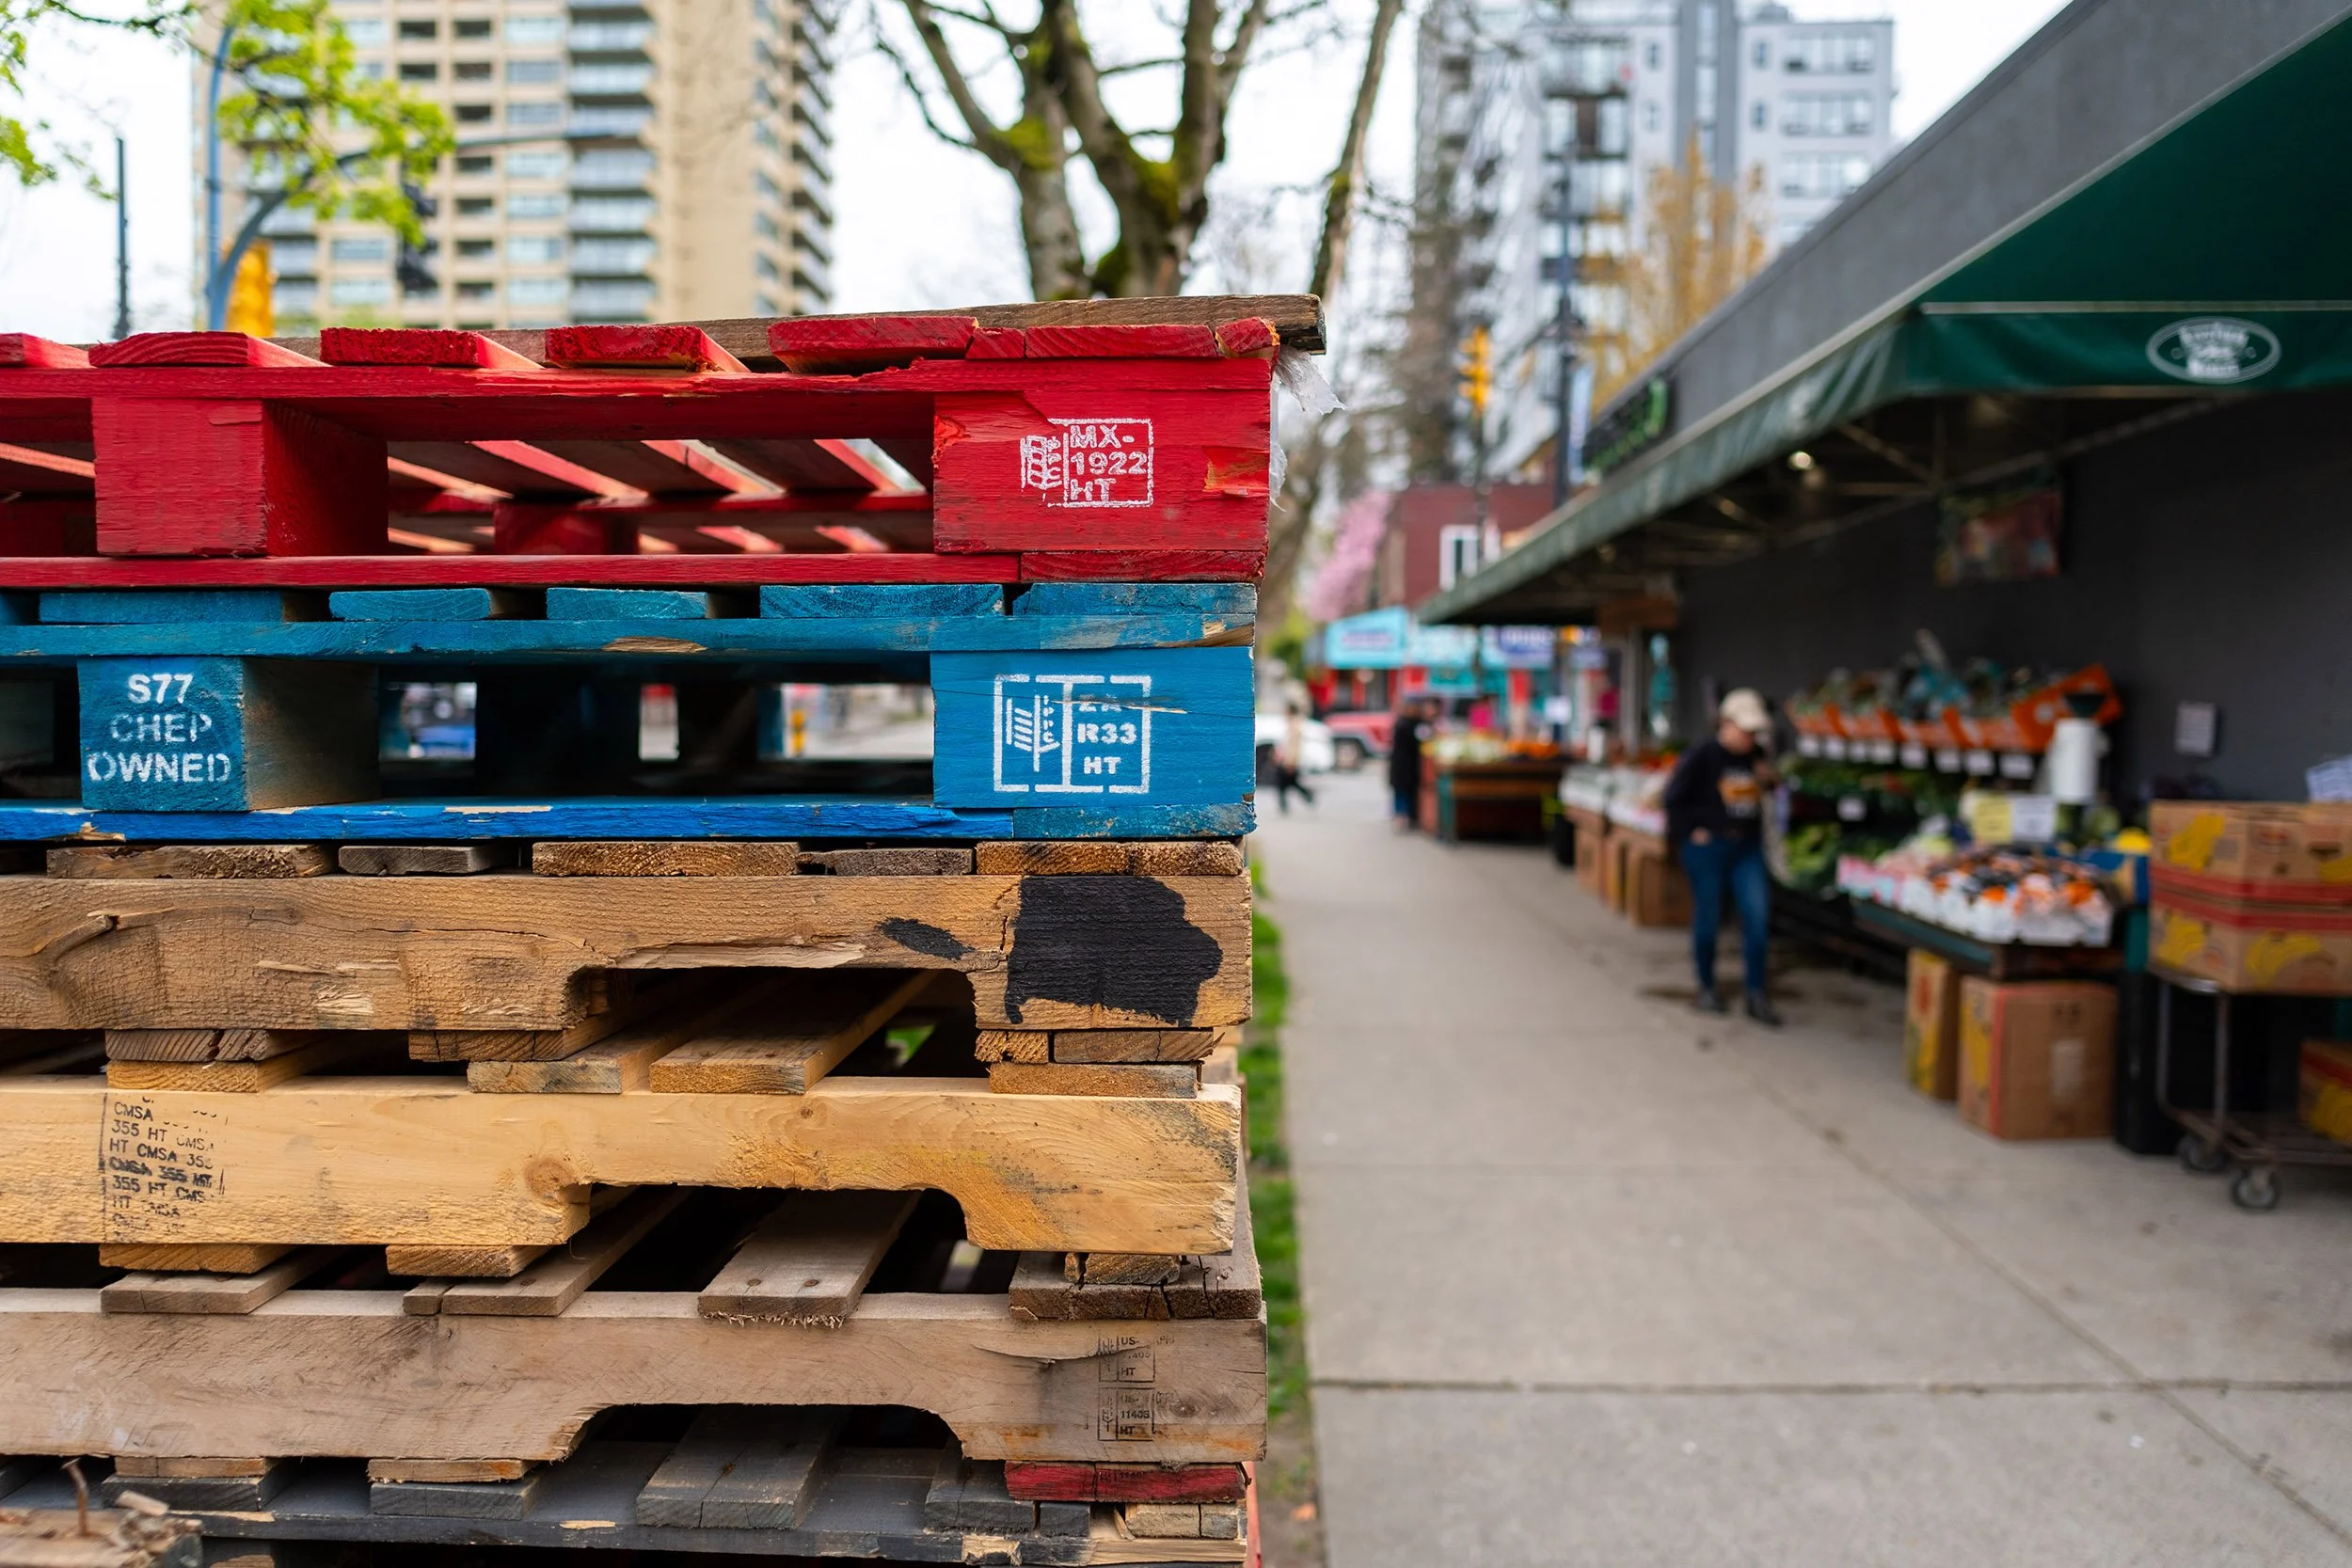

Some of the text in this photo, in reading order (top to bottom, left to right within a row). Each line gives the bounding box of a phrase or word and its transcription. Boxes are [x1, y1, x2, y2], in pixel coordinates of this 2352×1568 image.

[1071, 451, 1148, 475] 1922
[1070, 478, 1117, 501] HT
[128, 673, 194, 704] S77
[110, 713, 213, 742] CHEP
[1077, 722, 1136, 744] R33
[87, 752, 231, 783] OWNED
[1084, 756, 1121, 774] HT
[114, 1101, 154, 1122] CMSA
[111, 1118, 140, 1137] 355
[148, 1127, 167, 1142] HT
[109, 1137, 129, 1153] HT
[136, 1143, 178, 1163] CMSA
[112, 1174, 141, 1193] 355
[148, 1181, 167, 1196] HT
[1121, 1337, 1140, 1346] US-
[1120, 1367, 1136, 1376] HT
[1120, 1426, 1136, 1435] HT
